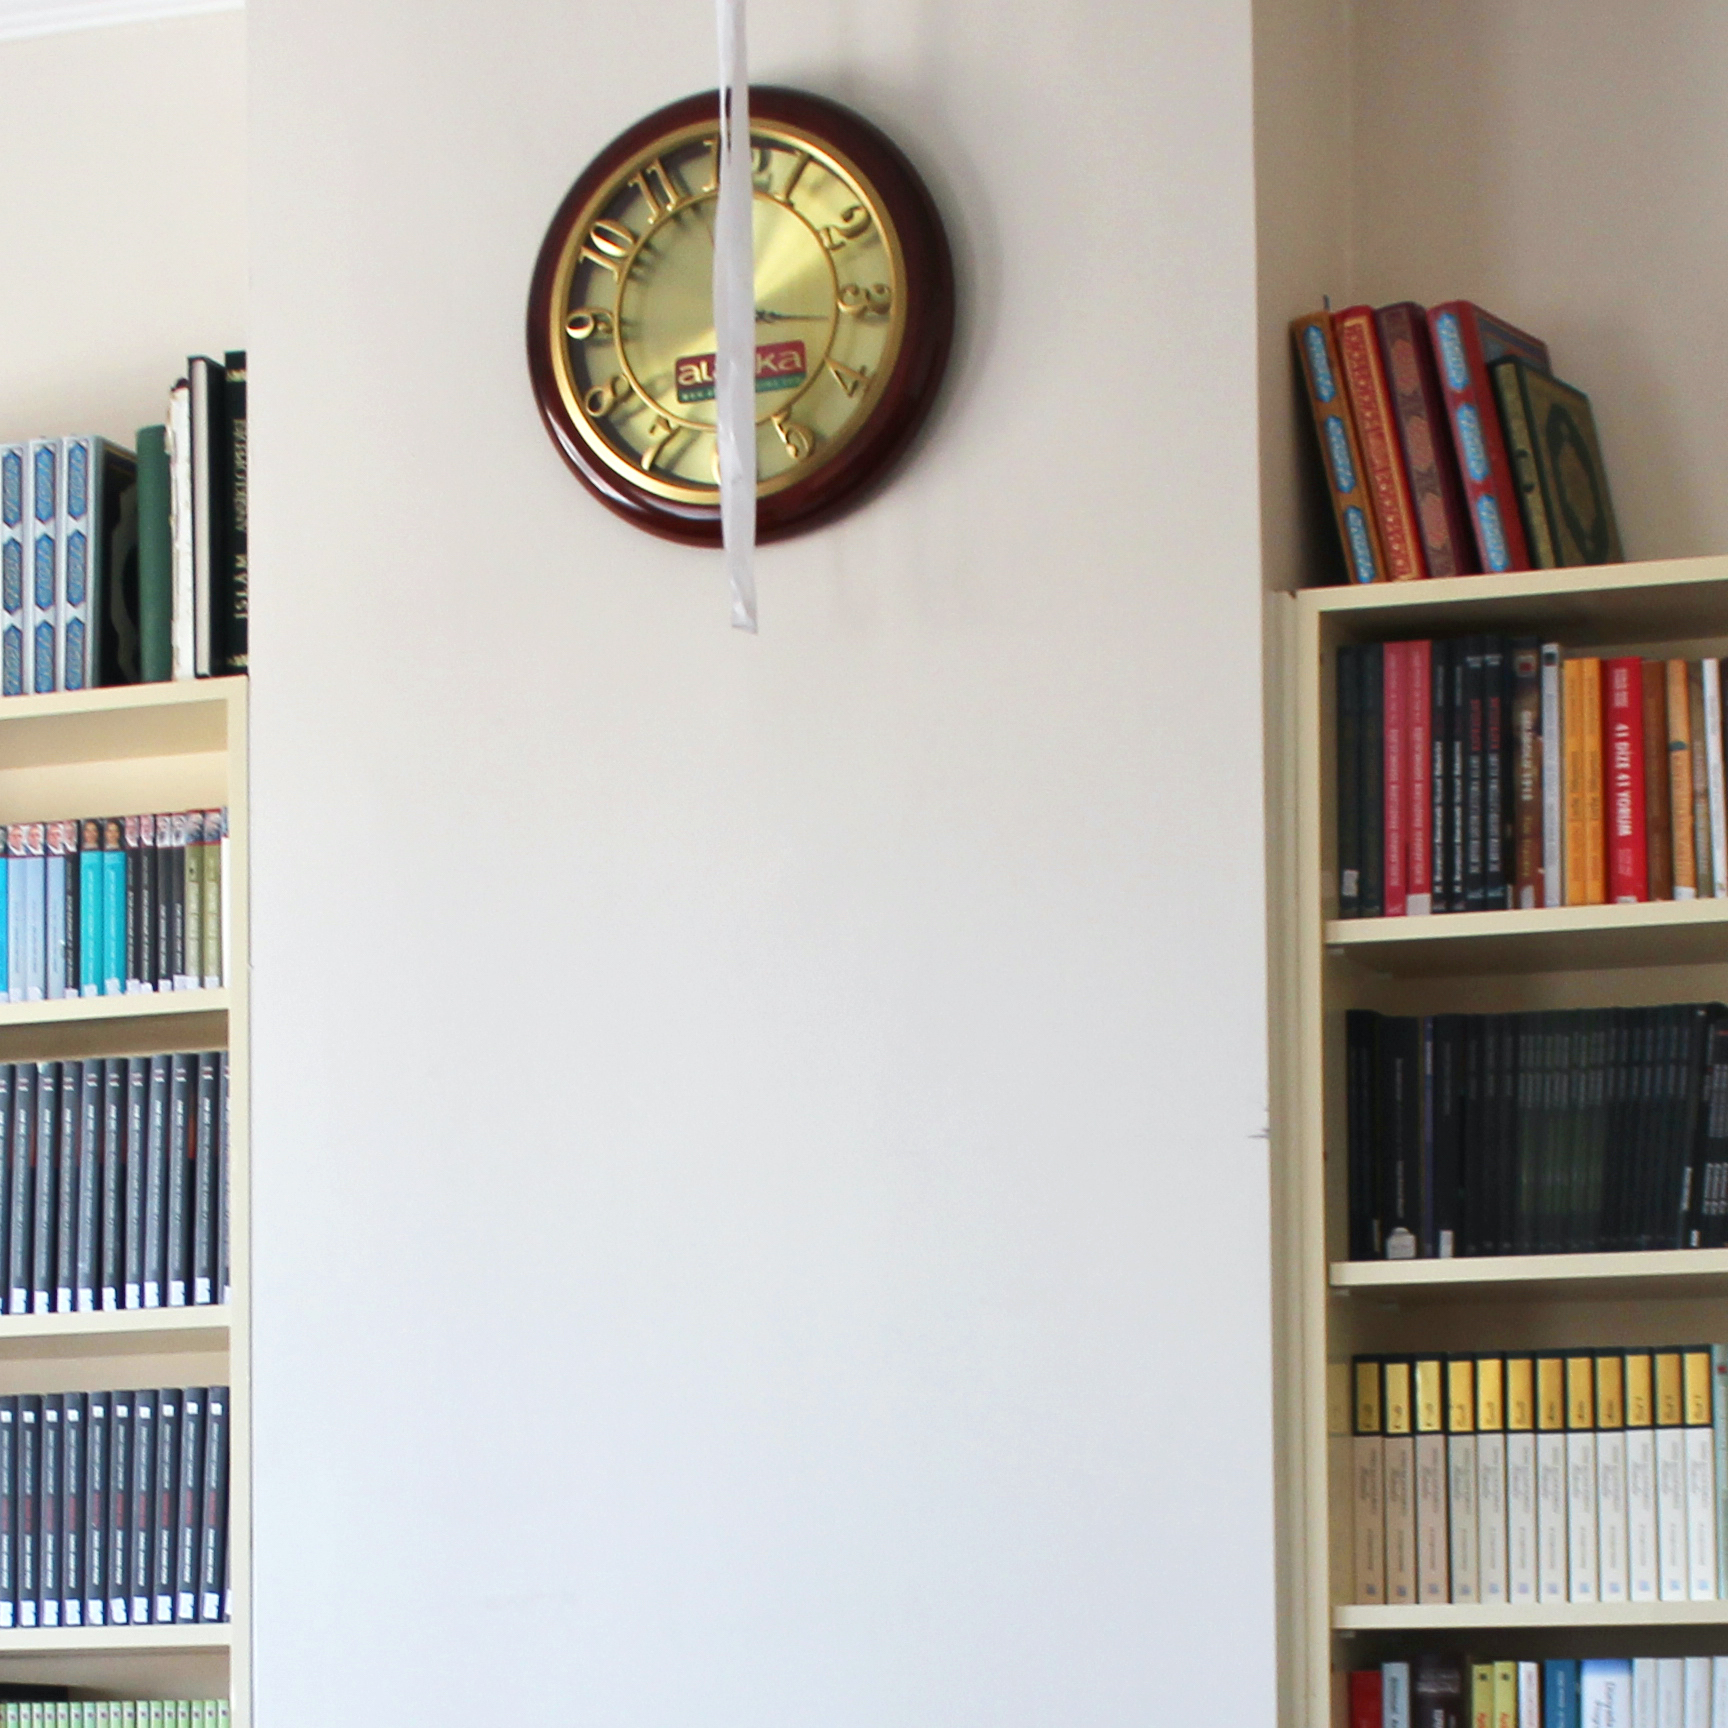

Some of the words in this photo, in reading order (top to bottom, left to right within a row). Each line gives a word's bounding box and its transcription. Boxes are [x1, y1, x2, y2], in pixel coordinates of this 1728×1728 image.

[629, 158, 678, 223] 11
[774, 148, 806, 207] 1
[580, 217, 635, 283] 10
[823, 205, 870, 252] 2
[838, 283, 892, 317] 3
[567, 307, 613, 341] 9
[586, 374, 629, 418] 8
[829, 357, 872, 398] 4
[642, 415, 678, 470] 7
[771, 411, 813, 459] 5
[1615, 722, 1630, 737] 41
[1615, 772, 1631, 787] 41
[1616, 790, 1632, 837] YORUM
